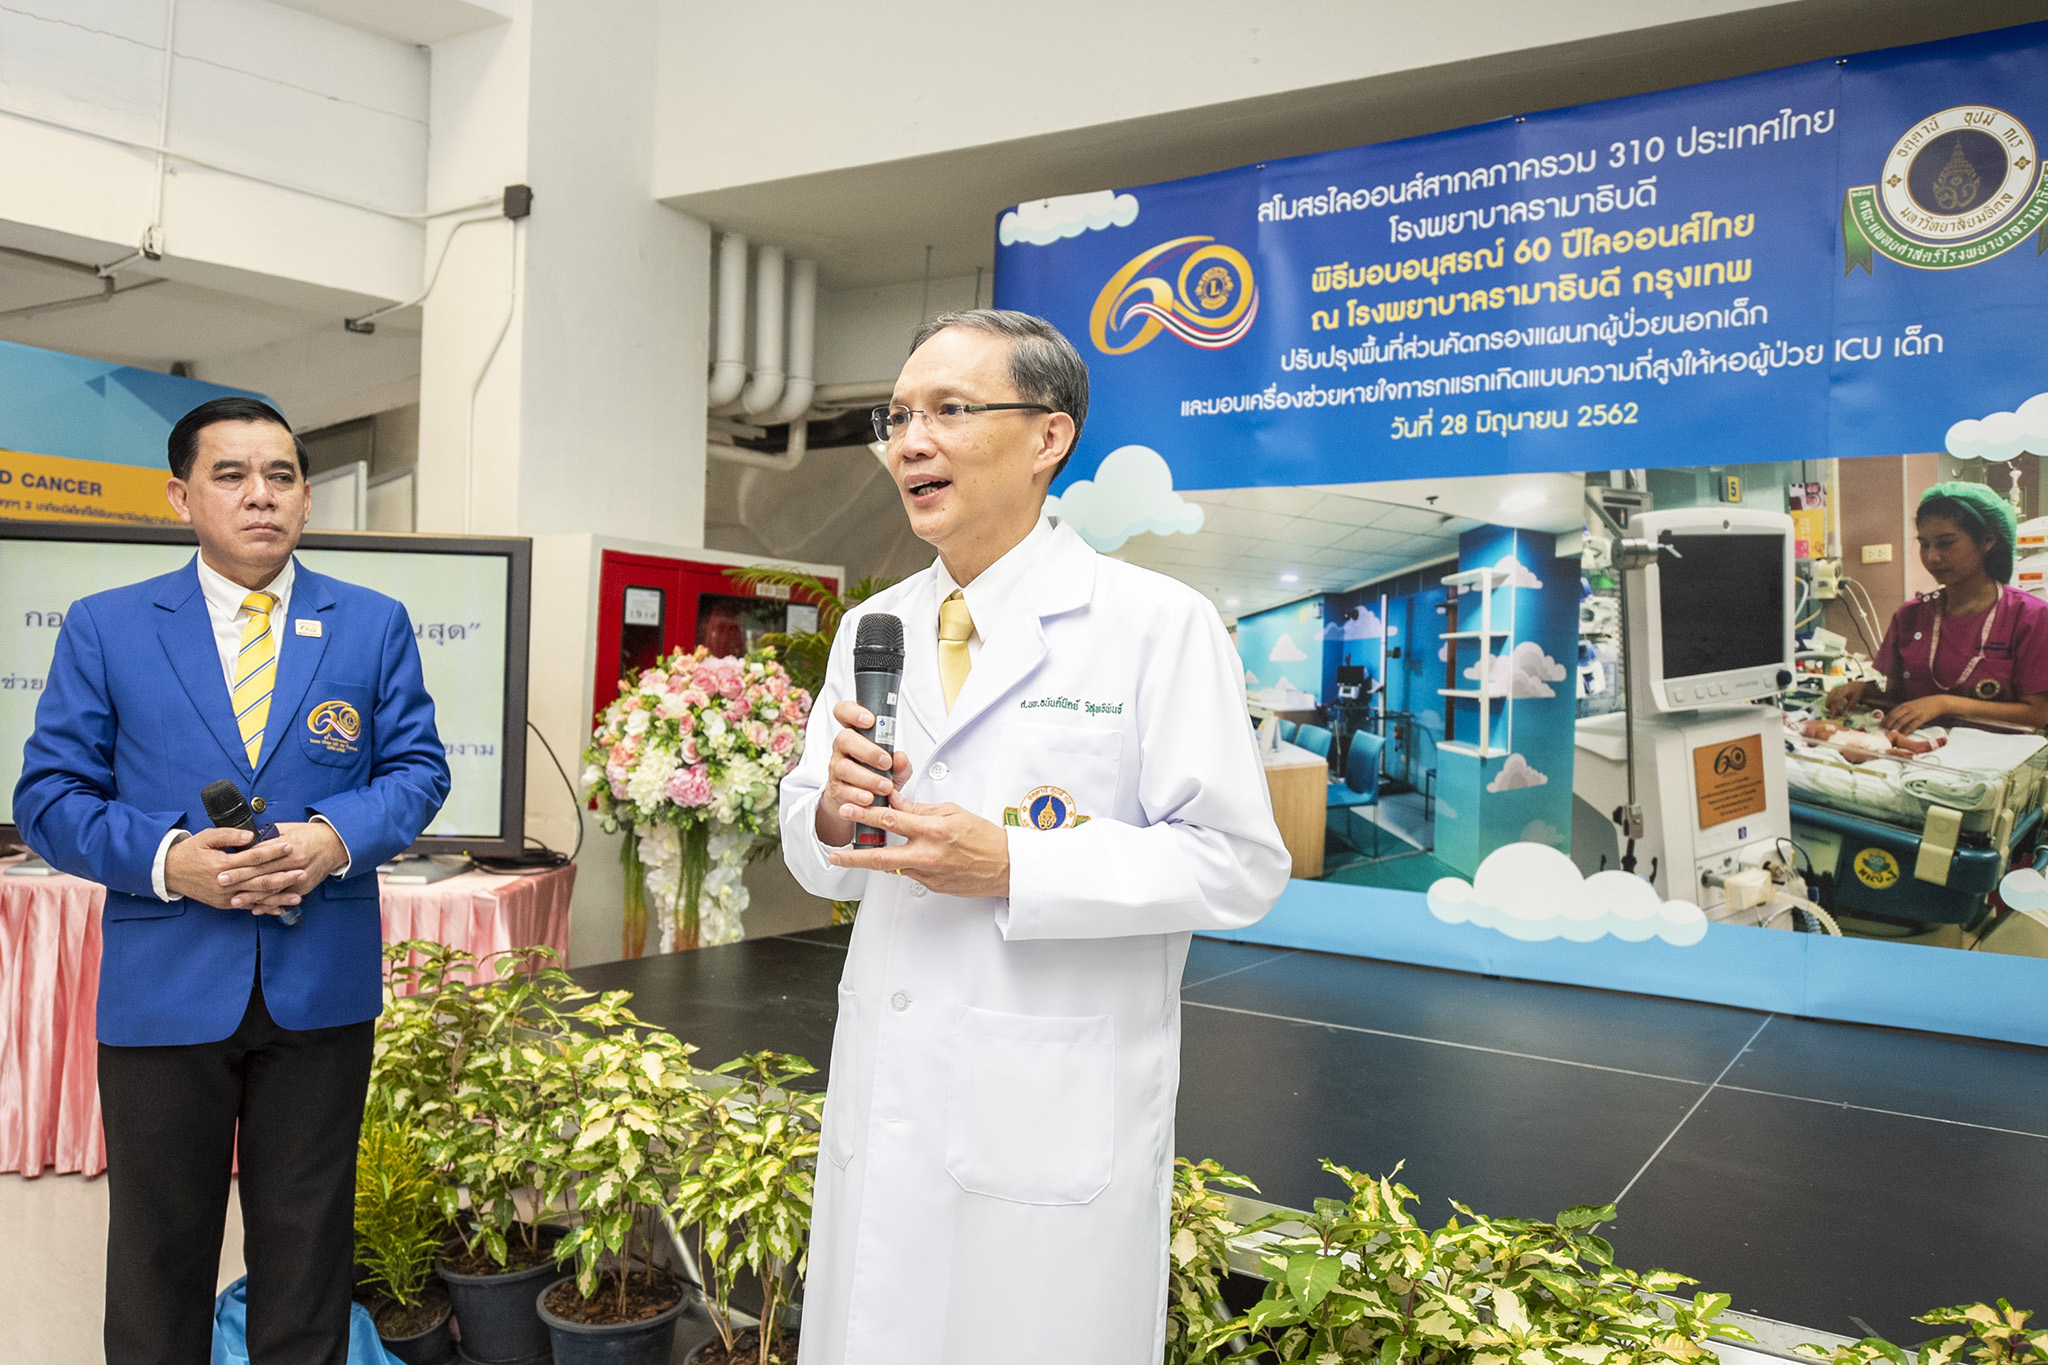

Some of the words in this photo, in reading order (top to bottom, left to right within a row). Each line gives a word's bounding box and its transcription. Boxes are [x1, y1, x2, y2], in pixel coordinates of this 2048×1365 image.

[1257, 148, 1597, 222] สโมสรไลออนส์สากลภาครวม
[1608, 136, 1665, 168] 310
[1676, 107, 1835, 158] ประเทศไทย
[1389, 175, 1658, 244] โรงพยาบาลรามาธิบดี
[1311, 237, 1505, 293] พิธีมอบอนุสรณ์
[1513, 236, 1552, 264] 60
[1561, 211, 1756, 259] ปีไลออนส์ไทย
[1311, 309, 1340, 332] ณ
[1346, 266, 1622, 327] โรงพยาบาลรามาธิบดี
[1631, 257, 1754, 300] กรุงเทพ
[1180, 341, 1824, 417] และมอบเครื่องช่วยหายใจทารกแรกเกิดแบบความถี่สูงให้หอผู้ป่วย
[1834, 335, 1882, 362] ICU
[1894, 324, 1944, 357] เด็ก
[1281, 296, 1769, 373] ปรับปรุงพื้นที่ส่วนคัดกรองแผนกผู้ป่วยนอกเด็ก
[1390, 408, 1434, 440] วันที่
[1439, 413, 1469, 436] 28
[1475, 409, 1569, 438] มิถุนายน
[1577, 401, 1639, 428] 2562
[21, 473, 103, 497] CANCER
